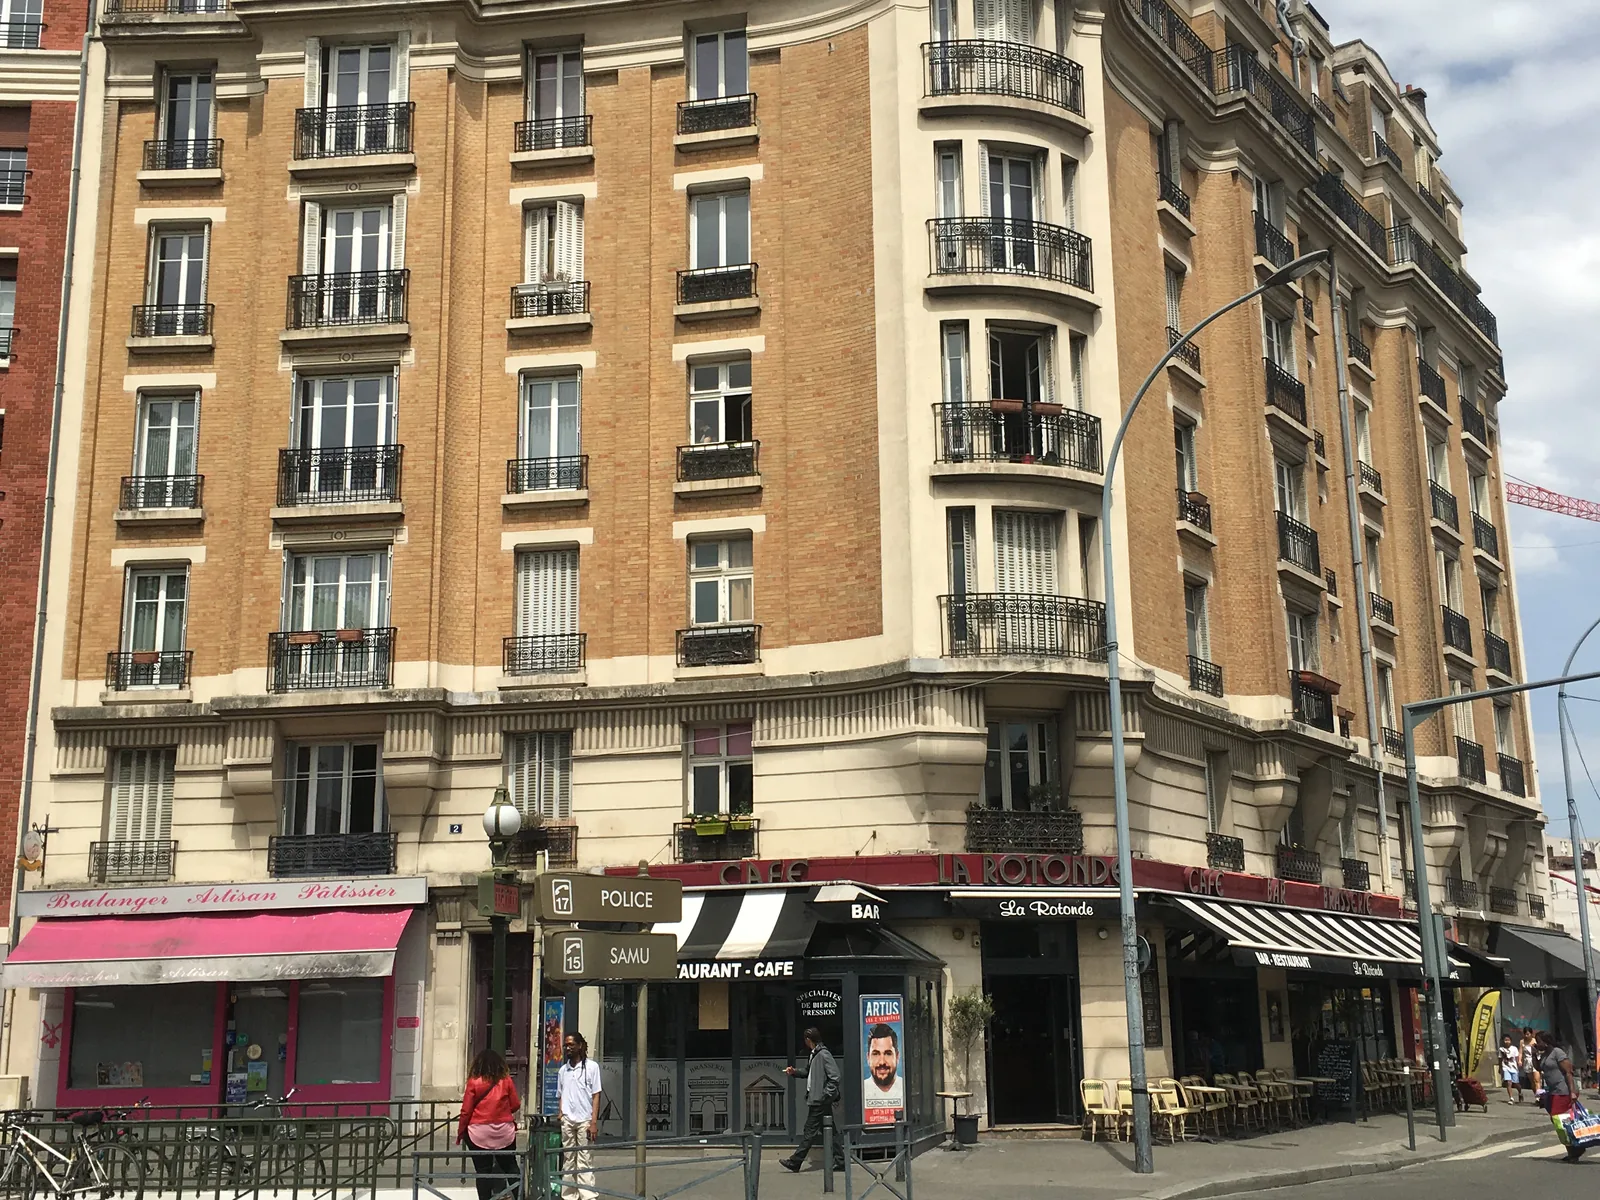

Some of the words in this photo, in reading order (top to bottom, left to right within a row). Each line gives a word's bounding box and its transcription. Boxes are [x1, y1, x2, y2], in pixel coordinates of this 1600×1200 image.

[453, 825, 459, 833] 2
[720, 861, 807, 884] CAFE
[938, 854, 971, 883] LA
[1188, 870, 1224, 897] CAFE
[47, 892, 168, 912] Boulanger
[188, 887, 277, 904] Artisan
[298, 883, 396, 899] Pâtissier
[601, 890, 653, 908] POLICE
[1267, 880, 1286, 904] BAR
[556, 898, 569, 910] 17
[1000, 900, 1025, 916] La
[1029, 901, 1094, 916] Rotonde
[1323, 887, 1373, 915] BRASSERIE
[851, 904, 880, 919] BAR
[567, 957, 580, 969] 15
[610, 947, 650, 964] SAMU
[1255, 953, 1269, 965] BAR
[1273, 955, 1311, 968] RESTAURANT
[163, 966, 229, 978] Artisan
[676, 963, 741, 979] AURANT
[754, 961, 793, 977] CAFE
[796, 990, 842, 1002] SPECIALITES
[866, 1002, 899, 1016] ARTUS
